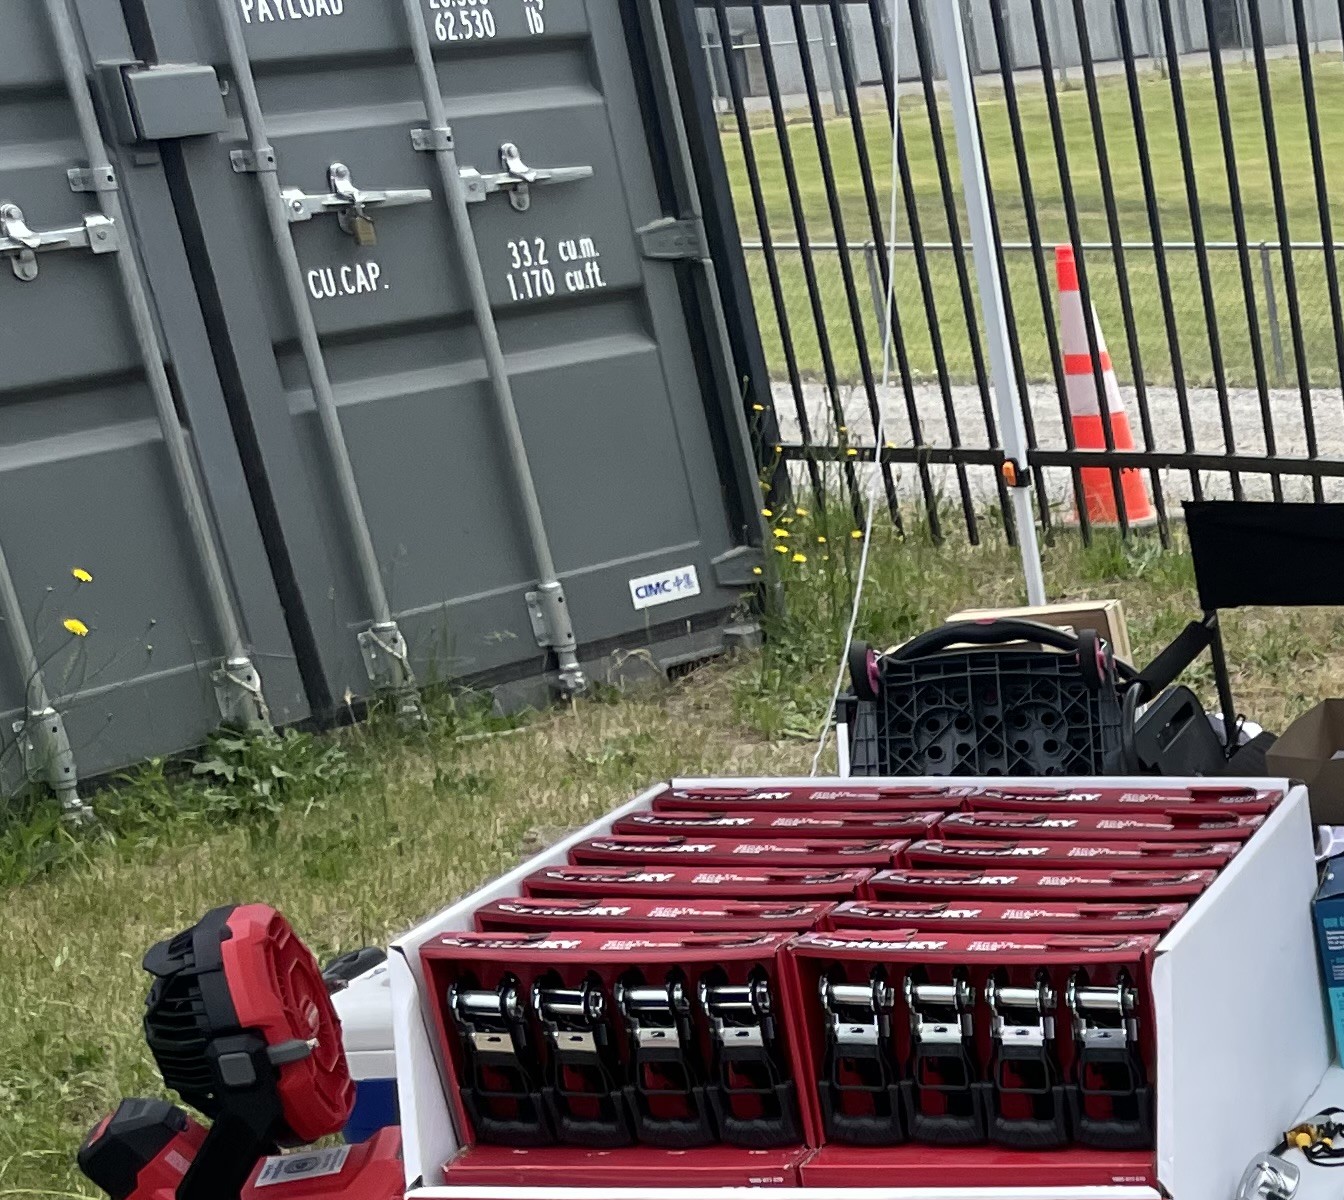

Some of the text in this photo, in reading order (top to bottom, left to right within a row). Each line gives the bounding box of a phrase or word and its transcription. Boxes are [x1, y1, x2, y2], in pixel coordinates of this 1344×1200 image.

[435, 10, 496, 41] 62.530
[526, 6, 544, 34] lb
[507, 236, 600, 269] 33.2 cu.m.
[307, 262, 389, 299] CU.CAP.
[507, 262, 606, 301] 1.170 cu.ft.
[635, 580, 672, 599] CIMC
